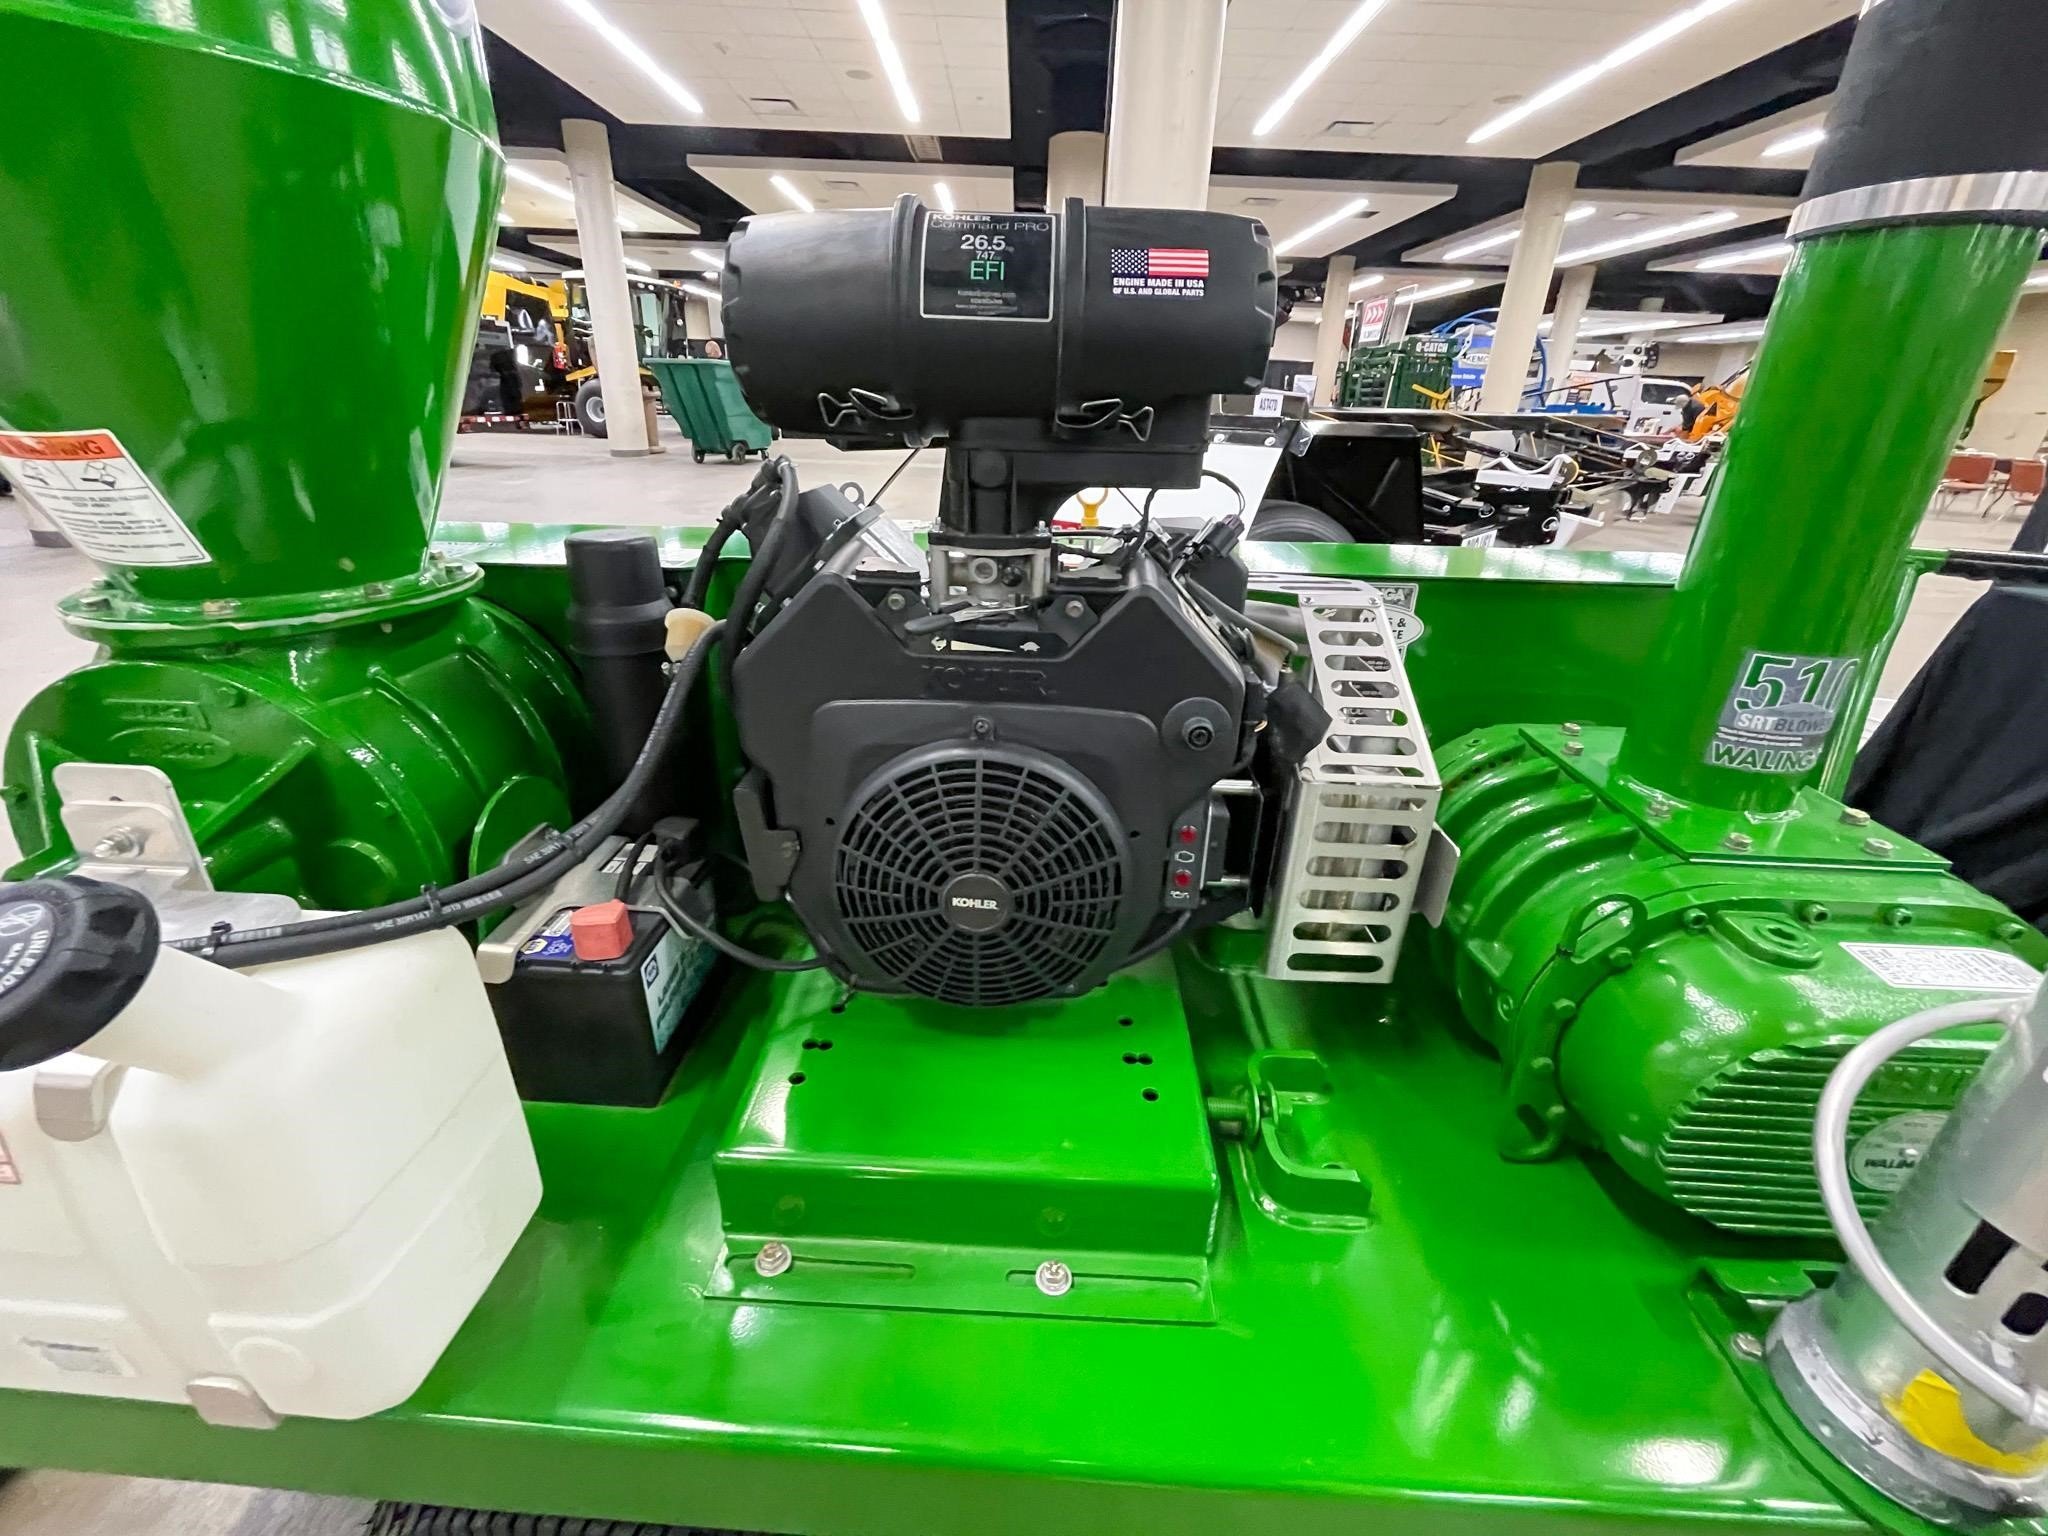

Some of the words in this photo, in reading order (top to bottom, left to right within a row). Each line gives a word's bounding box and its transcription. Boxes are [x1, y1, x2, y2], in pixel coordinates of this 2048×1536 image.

[932, 213, 991, 222] KOHLER
[931, 219, 1010, 231] Command
[1014, 221, 1049, 232] PRO
[960, 234, 1006, 251] 26.5
[975, 250, 996, 260] 747
[970, 260, 1005, 280] EFI
[1113, 277, 1145, 287] ENGINE
[1147, 278, 1173, 287] MADE
[1175, 279, 1185, 288] IN
[1186, 279, 1205, 288] USA
[1112, 287, 1123, 295] OF
[1123, 287, 1137, 295] U.S.
[1154, 288, 1181, 296] GLOBAL
[1182, 289, 1205, 297] PARTS
[951, 896, 1000, 911] KOHLER
